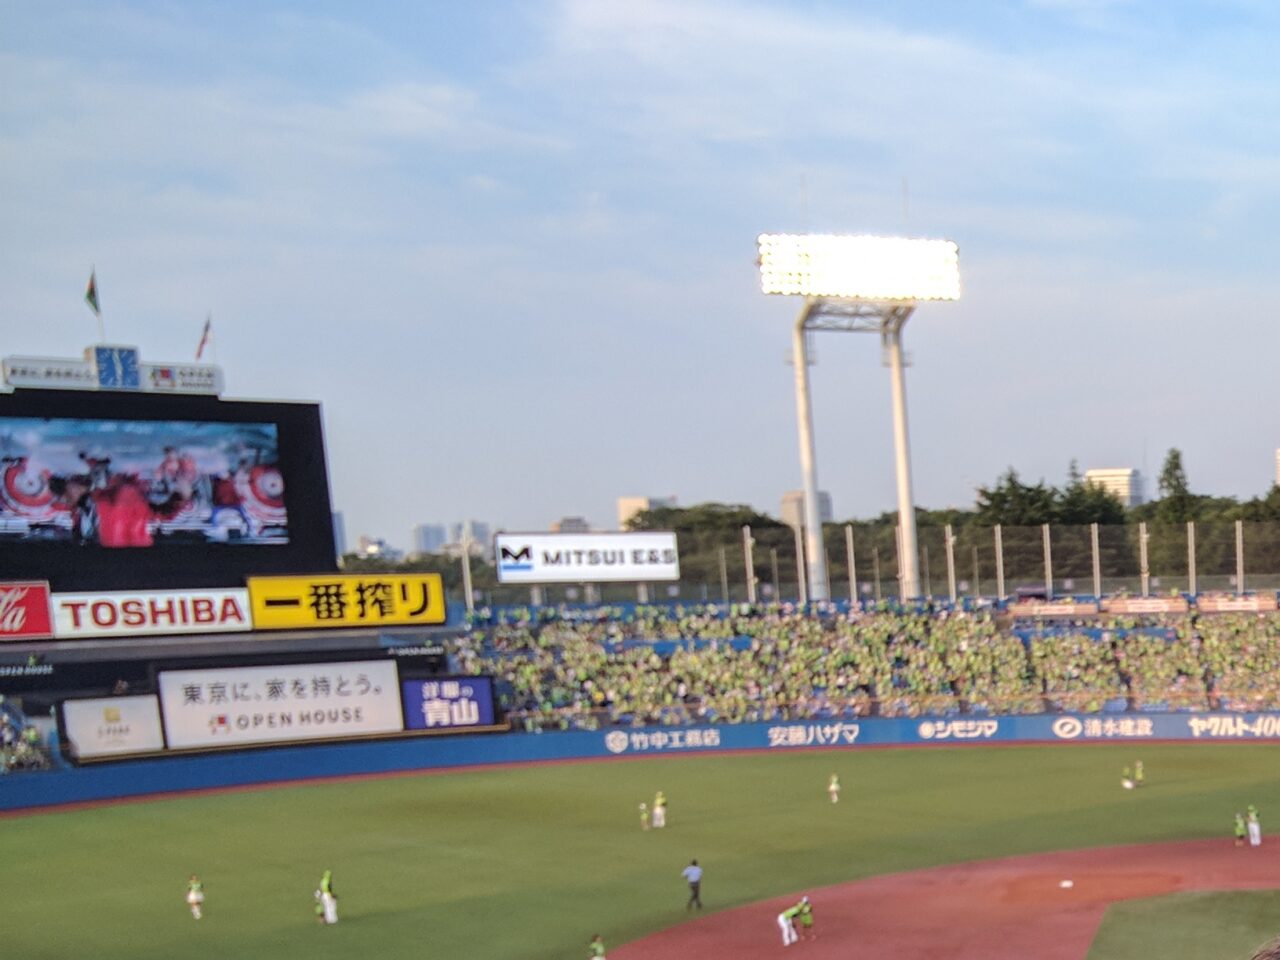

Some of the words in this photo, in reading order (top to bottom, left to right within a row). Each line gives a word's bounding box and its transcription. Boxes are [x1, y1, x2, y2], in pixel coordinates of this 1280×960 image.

[543, 549, 625, 566] MITSUI
[631, 548, 677, 565] E&S
[61, 596, 243, 629] TOSHIBA
[264, 581, 430, 621] 一番搾り
[235, 711, 292, 730] OPEN
[299, 707, 365, 725] HOUSE
[421, 698, 480, 727] 青山
